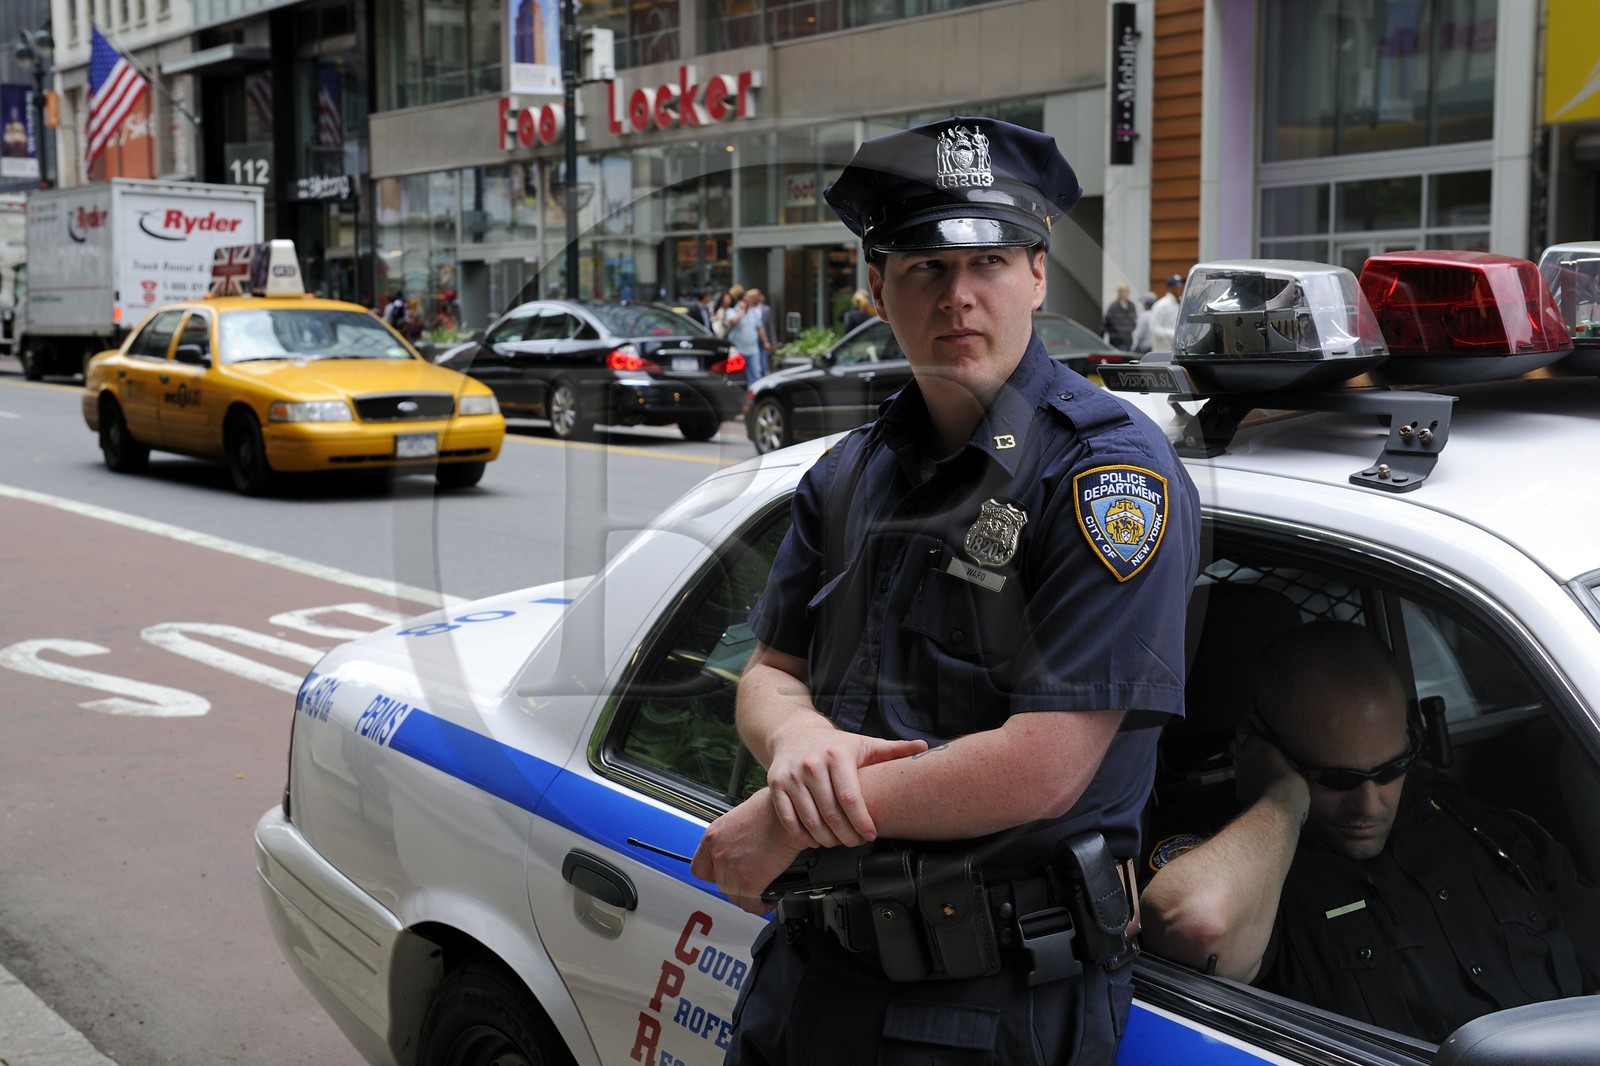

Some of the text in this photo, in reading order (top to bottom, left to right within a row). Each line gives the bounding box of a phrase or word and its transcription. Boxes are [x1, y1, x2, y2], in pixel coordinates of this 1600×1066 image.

[498, 64, 763, 150] Foo Locker
[230, 158, 270, 184] 112
[163, 208, 243, 235] Ryder
[1084, 483, 1162, 505] DEPARTMENT
[1100, 472, 1147, 488] POLICE
[1085, 515, 1117, 559] CITY OF
[1131, 512, 1163, 567] NEW YORK
[966, 567, 987, 582] WARD
[355, 694, 409, 746] PBMS
[674, 910, 748, 991] COUR
[649, 960, 733, 1051] PROFE
